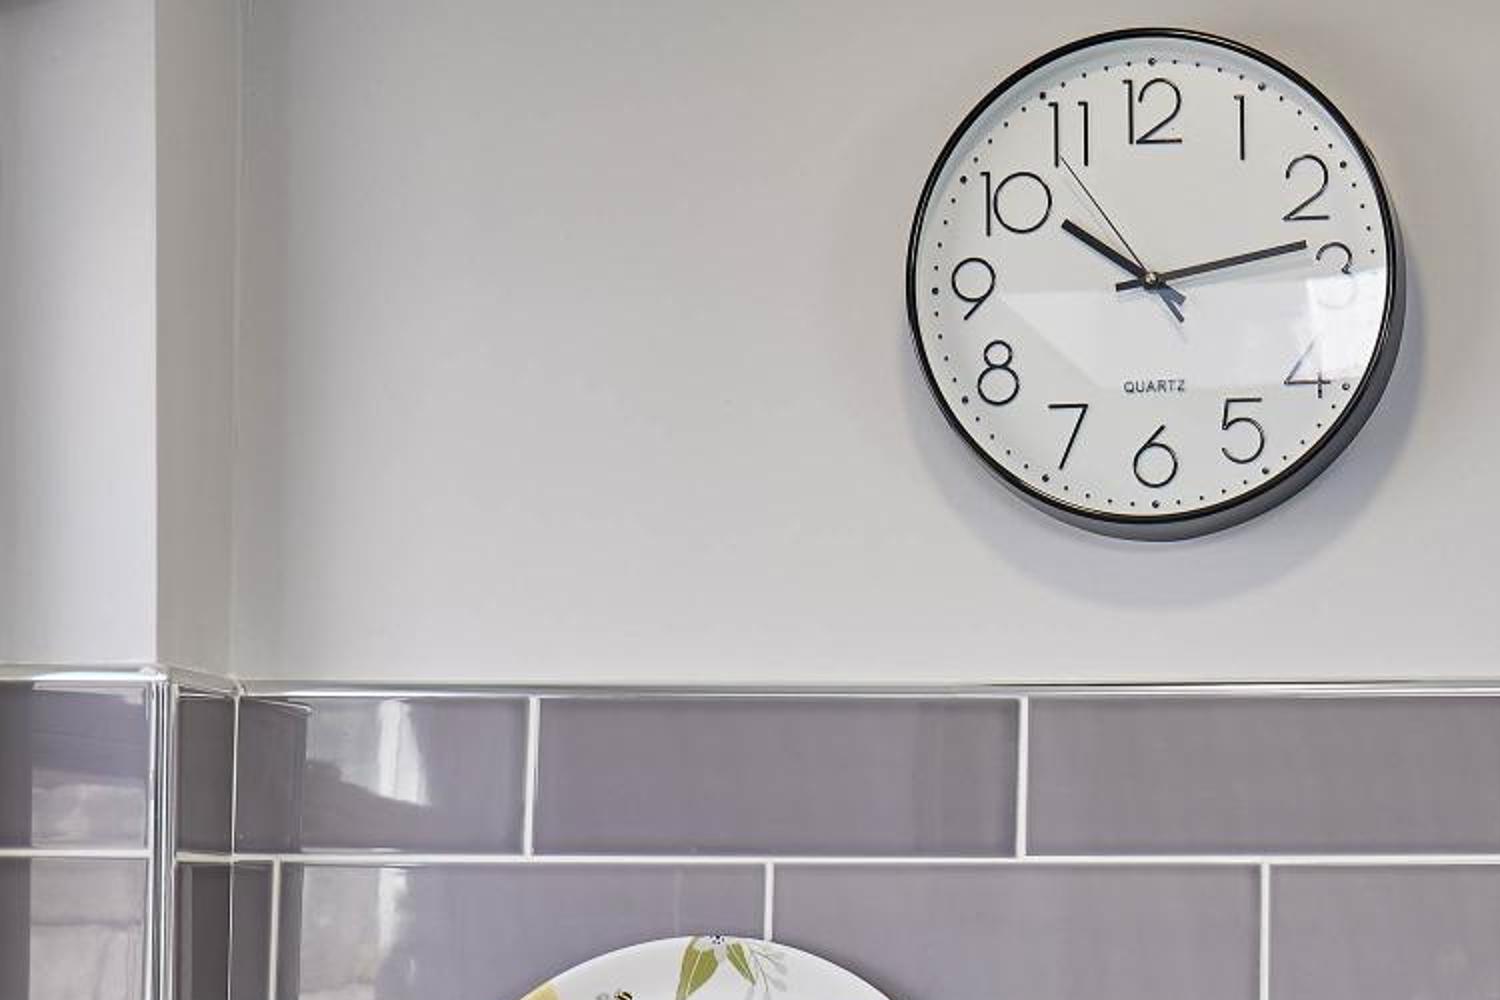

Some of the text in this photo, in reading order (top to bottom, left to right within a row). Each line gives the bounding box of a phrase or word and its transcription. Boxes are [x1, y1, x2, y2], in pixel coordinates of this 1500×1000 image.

[1048, 101, 1089, 167] 11
[1123, 78, 1183, 145] 12
[1234, 95, 1245, 160] 1
[981, 172, 1052, 236] 10
[1281, 155, 1330, 221] 2
[951, 258, 996, 320] 9
[1316, 242, 1358, 310] 3
[977, 340, 1019, 405] 8
[1123, 379, 1185, 393] QUARTZ
[1284, 339, 1331, 398] 4
[1048, 404, 1088, 470] 7
[1133, 425, 1178, 488] 6
[1222, 398, 1265, 464] 5
